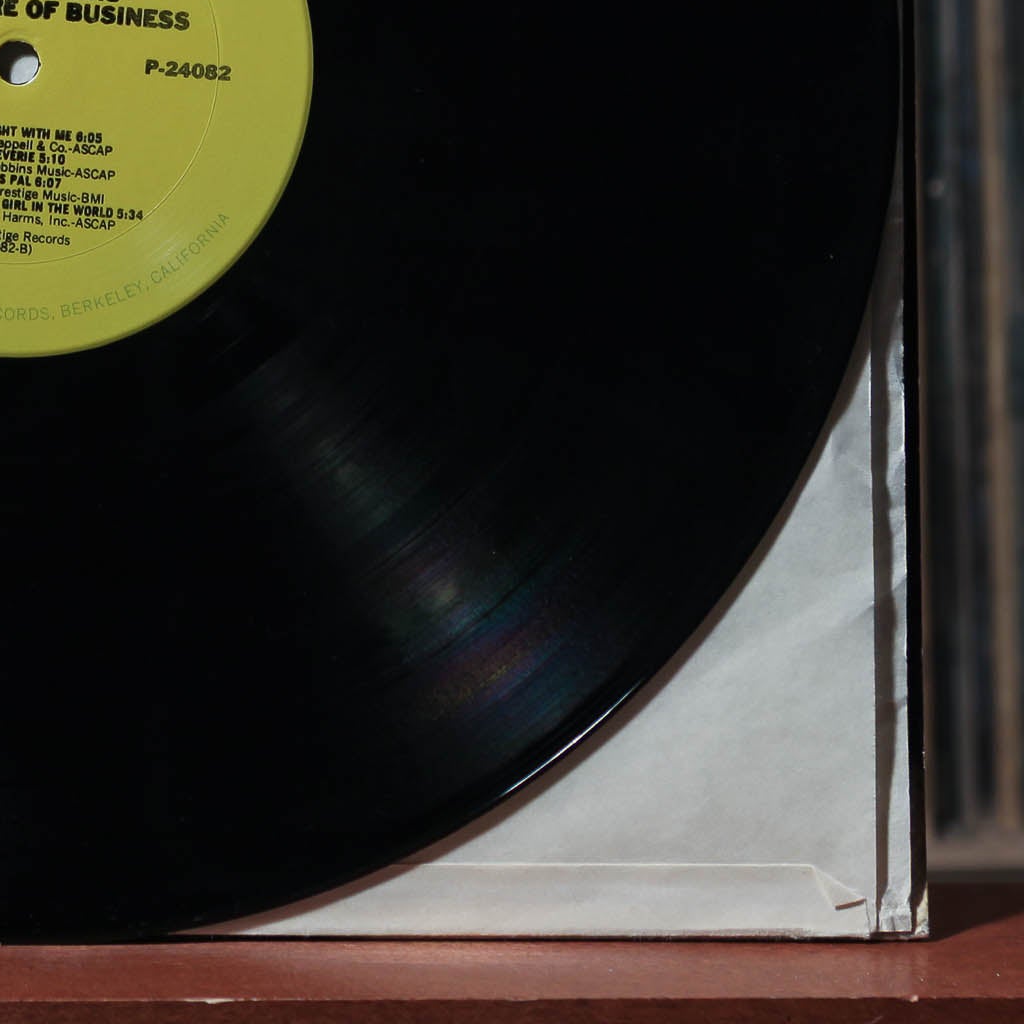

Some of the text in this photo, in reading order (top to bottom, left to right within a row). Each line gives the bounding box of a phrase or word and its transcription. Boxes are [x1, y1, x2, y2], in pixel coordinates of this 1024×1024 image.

[25, 0, 60, 20] OF
[65, 3, 191, 32] BUSINESS
[145, 59, 232, 82] P-24082
[21, 126, 51, 140] WITH
[54, 129, 73, 142] ME
[75, 130, 103, 144] 6:05
[36, 140, 46, 152] &
[49, 141, 114, 157] Co.-ASCAP
[38, 152, 66, 166] 5:10
[36, 164, 116, 181] Music-ASCAP
[9, 176, 32, 187] PAL
[34, 177, 62, 189] 6:07
[42, 189, 105, 205] Music-BMI
[1, 198, 28, 212] GIRL
[31, 201, 44, 213] IN
[47, 202, 70, 215] THE
[73, 205, 114, 219] WORLD
[116, 208, 144, 221] 5:34
[2, 211, 44, 226] Harms,
[49, 215, 116, 231] Inc.-ASCAP
[23, 231, 71, 246] Records
[60, 280, 150, 318] BERKELEY,
[150, 211, 230, 285] CALIFORNIA
